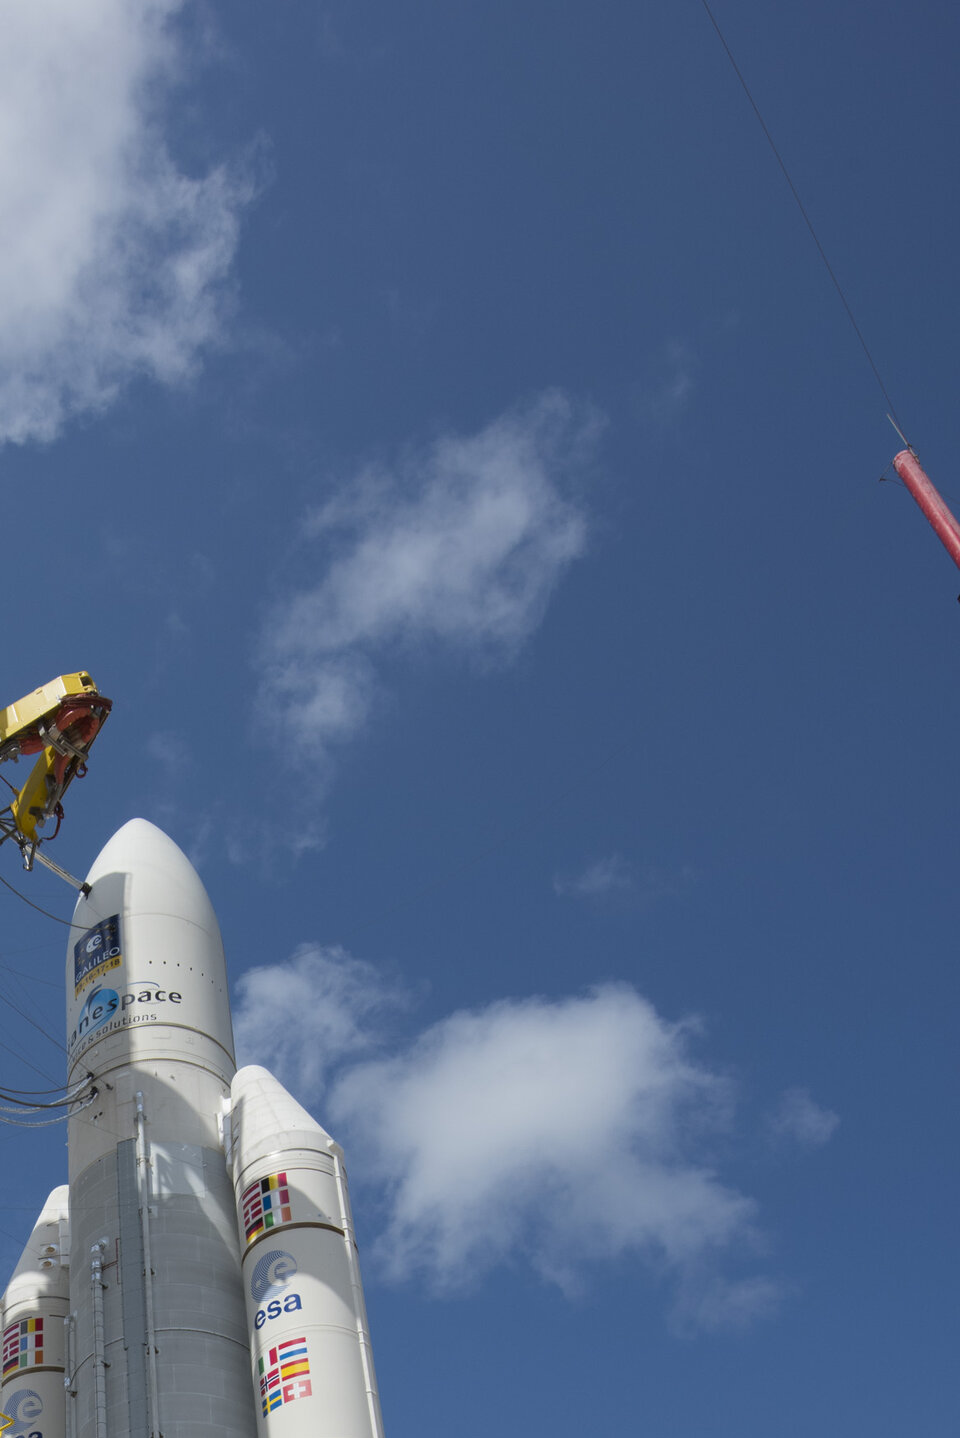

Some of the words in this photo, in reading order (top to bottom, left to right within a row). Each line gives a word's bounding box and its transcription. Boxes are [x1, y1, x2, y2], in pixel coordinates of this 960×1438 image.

[76, 946, 120, 982] GALILEO
[95, 1013, 158, 1039] solutions
[254, 1293, 303, 1330] esa
